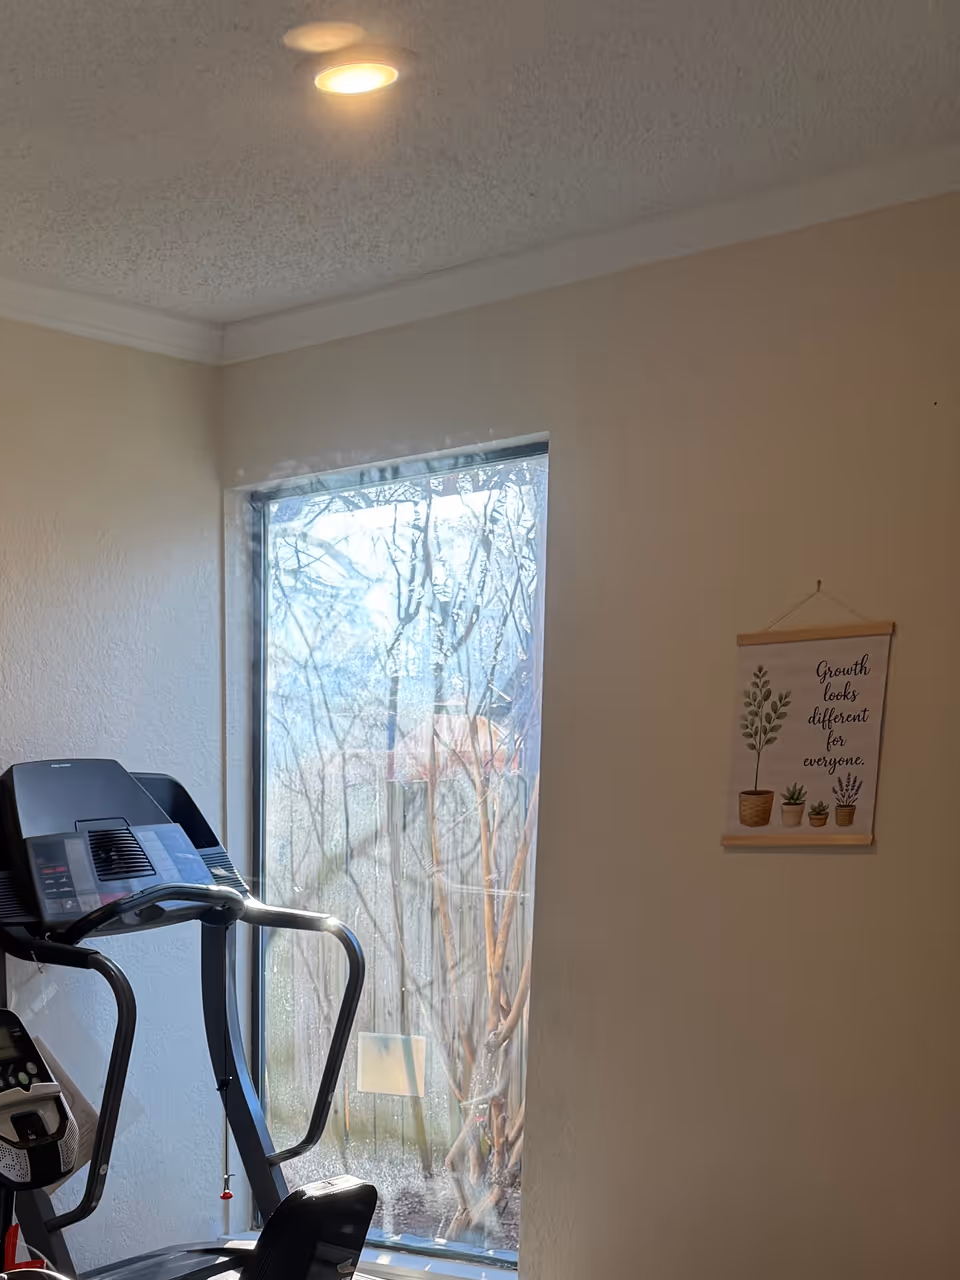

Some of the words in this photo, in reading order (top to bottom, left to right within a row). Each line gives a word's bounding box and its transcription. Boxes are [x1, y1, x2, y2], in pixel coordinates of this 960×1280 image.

[815, 653, 871, 684] Growth
[823, 681, 860, 702] looks
[807, 706, 870, 730] different
[826, 729, 847, 752] for
[803, 756, 865, 776] everyone.
